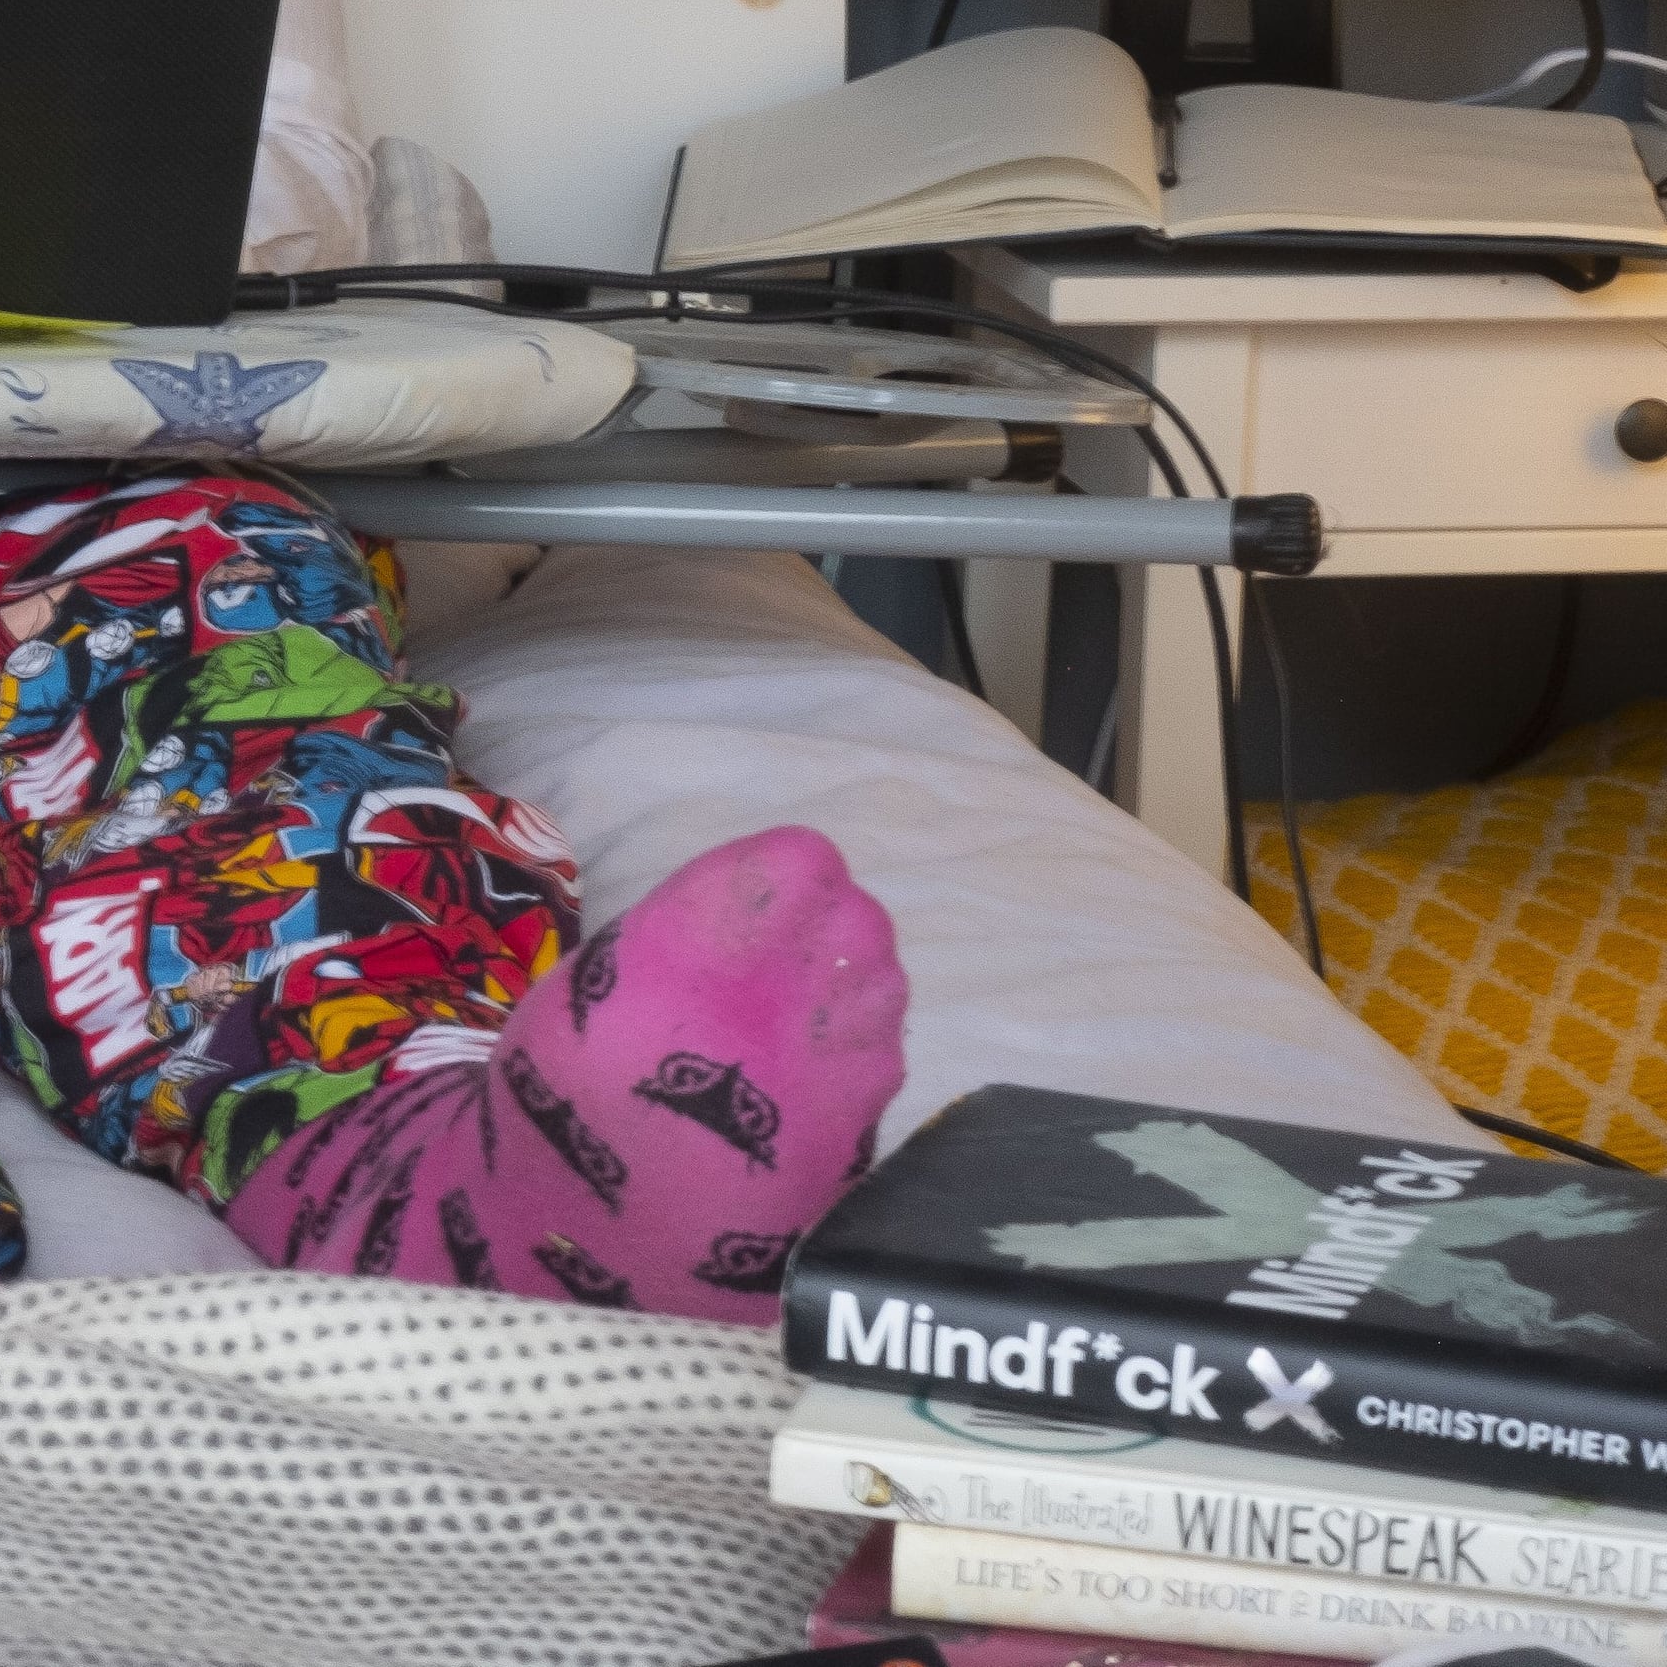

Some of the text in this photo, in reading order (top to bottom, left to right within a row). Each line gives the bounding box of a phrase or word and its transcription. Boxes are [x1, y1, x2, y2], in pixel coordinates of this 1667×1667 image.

[1355, 1395, 1631, 1465] CHRISTOPHER
[960, 1474, 1012, 1522] The
[1174, 1491, 1491, 1584] WINESPEAK
[955, 1556, 1063, 1593] LIFE'S
[1071, 1568, 1152, 1602] TOO
[1161, 1576, 1280, 1617] SHORT
[1317, 1594, 1436, 1632] DRINK
